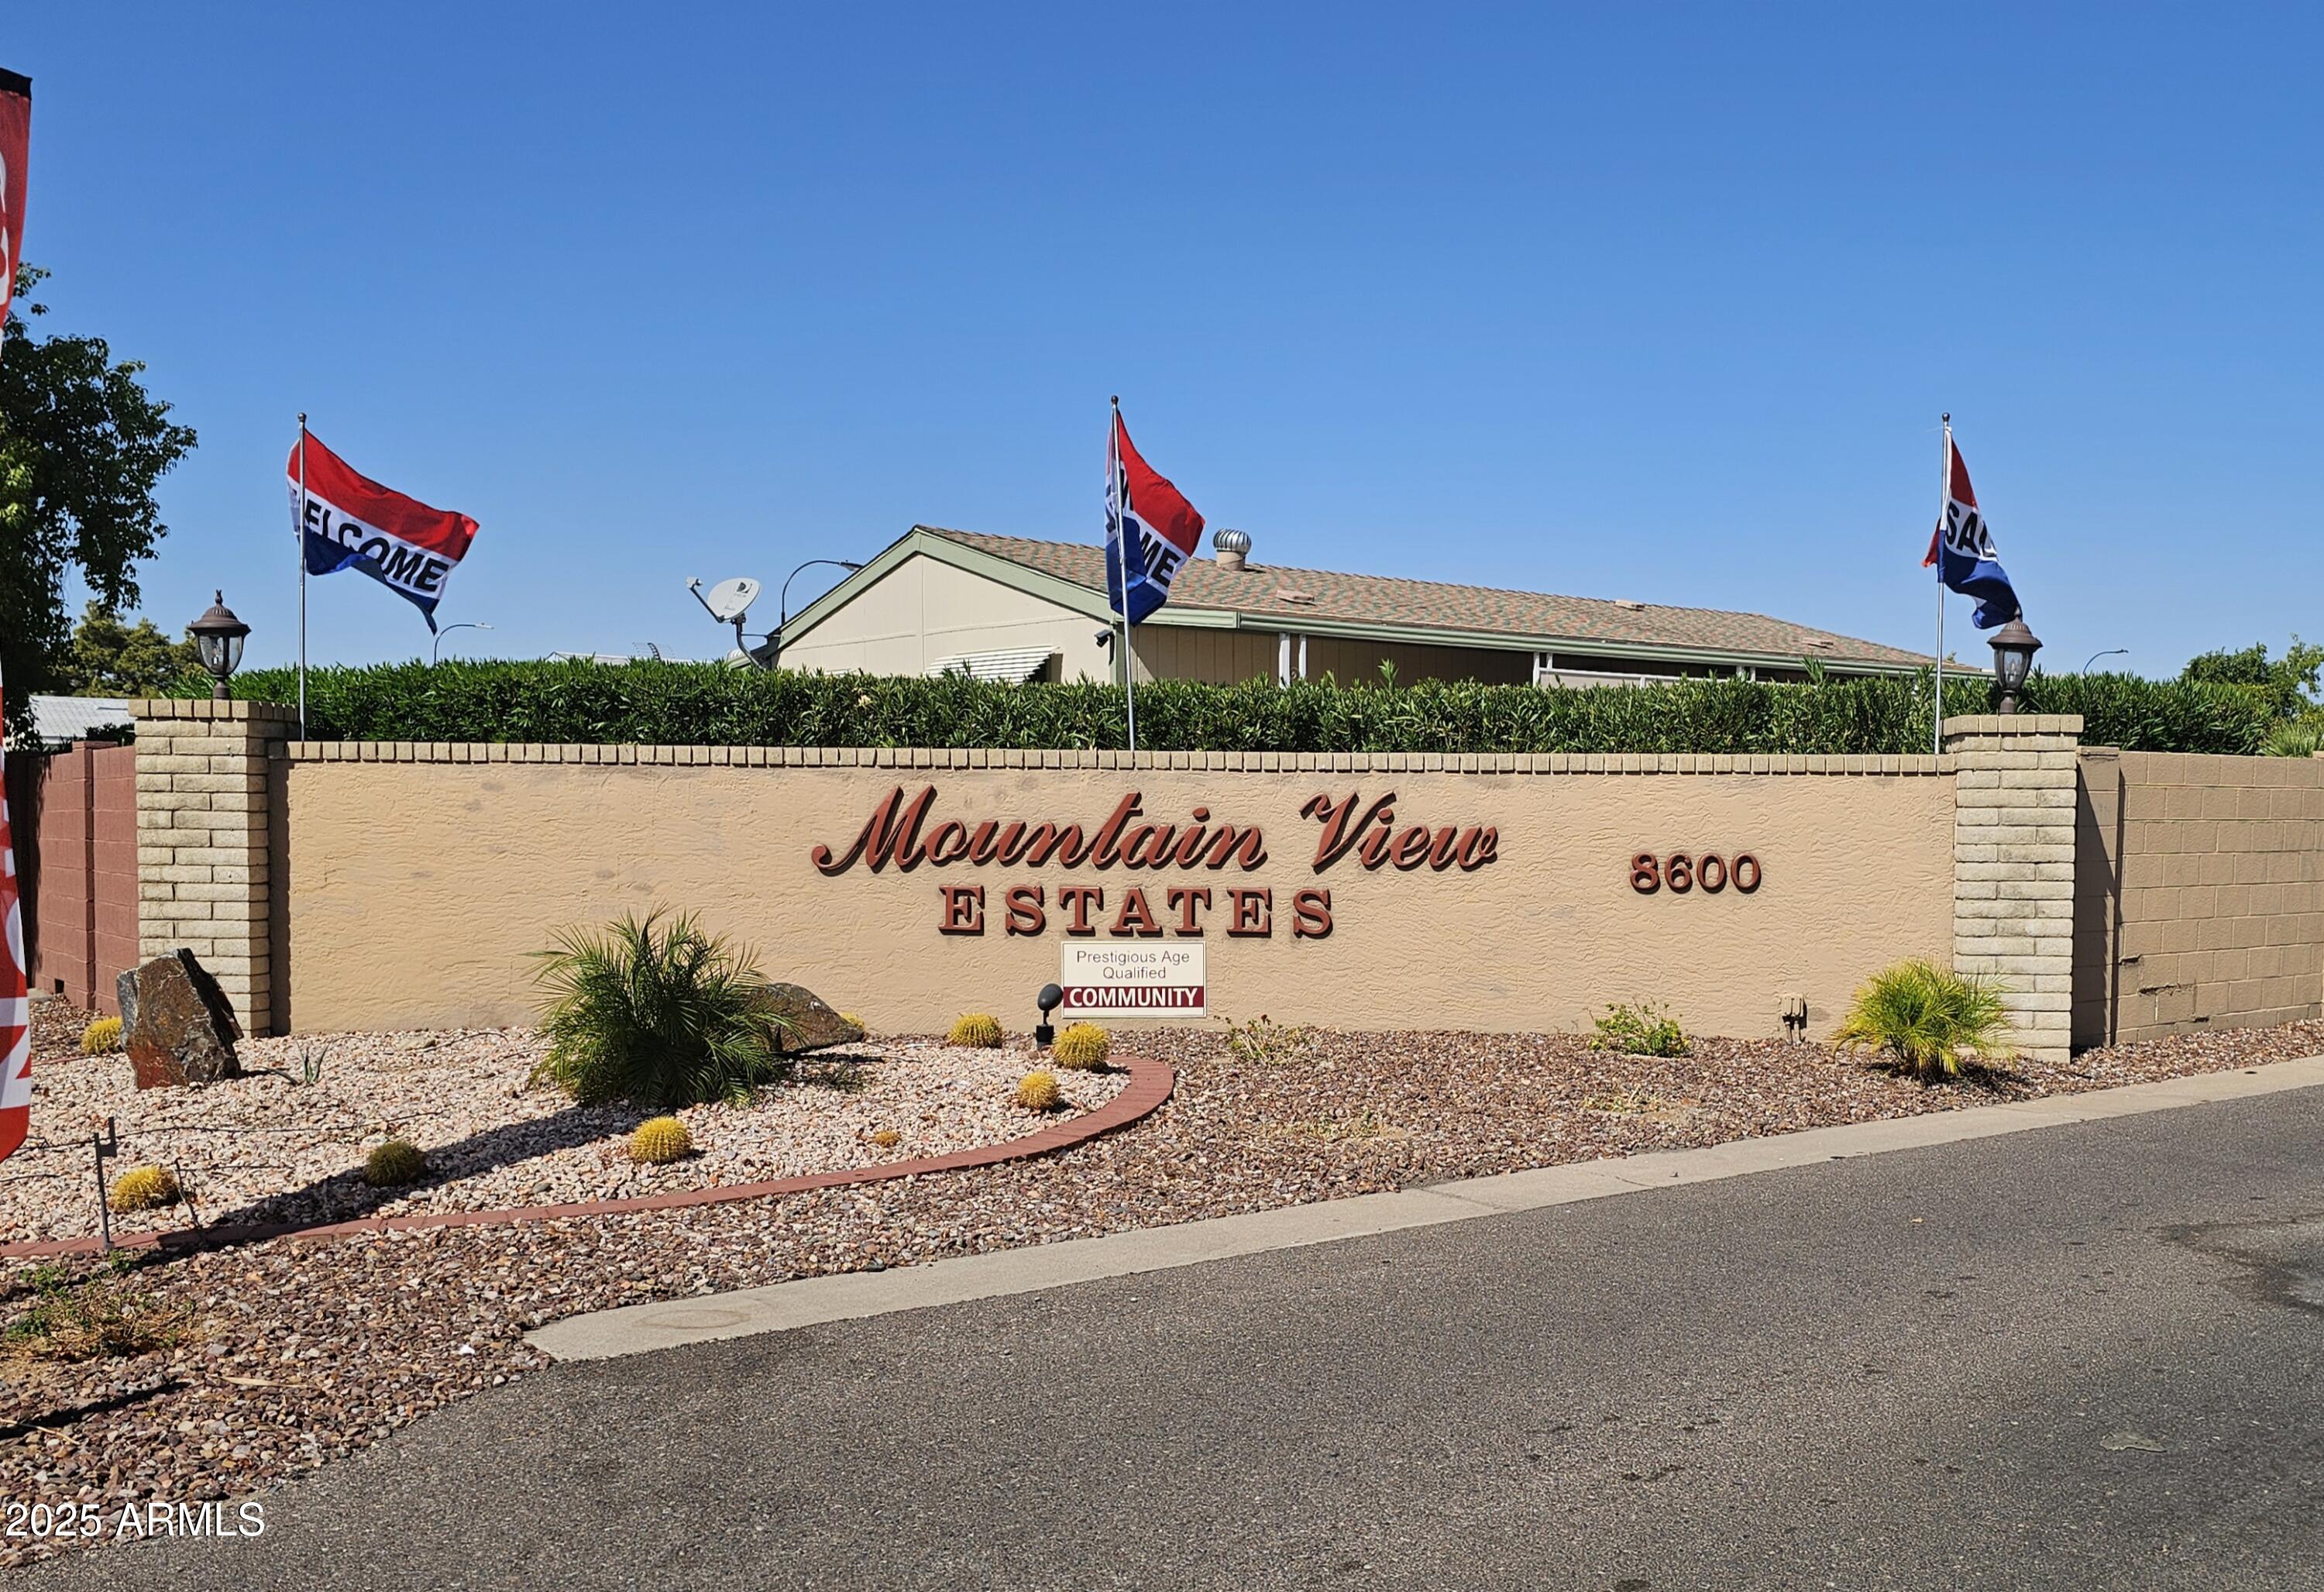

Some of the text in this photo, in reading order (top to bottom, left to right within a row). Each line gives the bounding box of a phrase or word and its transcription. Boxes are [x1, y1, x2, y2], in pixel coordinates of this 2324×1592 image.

[293, 490, 449, 592] ELCOME
[1945, 500, 1997, 558] SAL
[811, 784, 1499, 876] Mountain View
[1630, 851, 1762, 893] 8600
[937, 883, 1335, 939] ESTATES
[1077, 951, 1190, 966] Prestigious Age
[1102, 966, 1167, 979] Qualified
[1069, 987, 1198, 1007] COMMUNITY
